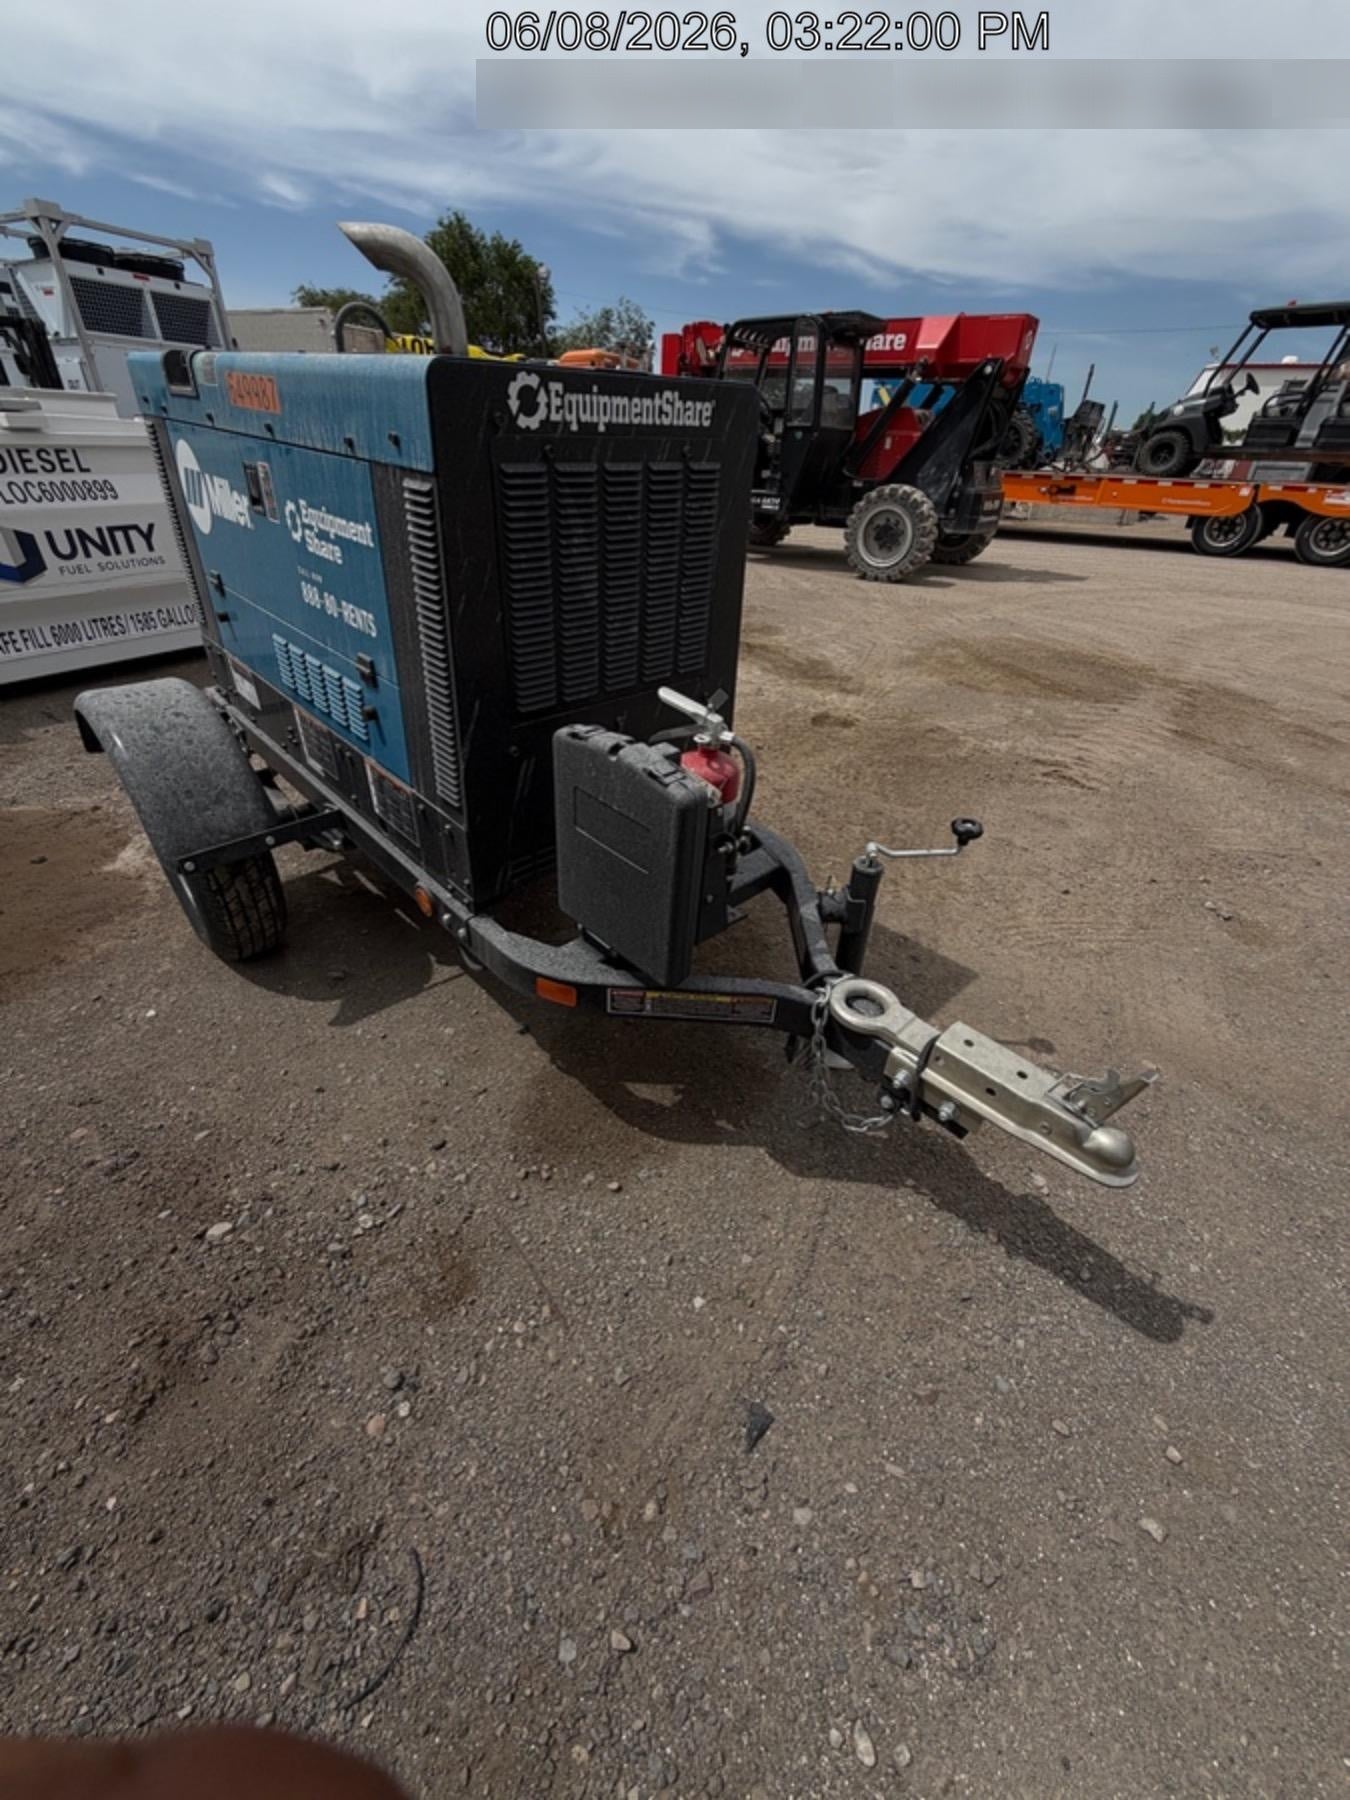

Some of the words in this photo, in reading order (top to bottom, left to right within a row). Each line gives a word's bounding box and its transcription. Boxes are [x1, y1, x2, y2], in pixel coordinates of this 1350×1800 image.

[548, 381, 712, 432] EquipmentShare
[204, 471, 253, 529] Miller
[299, 498, 374, 548] Equipment
[44, 522, 155, 561] UNITY
[304, 529, 343, 564] Share
[58, 563, 92, 577] FUEL
[97, 555, 166, 573] SOLUTIONS
[19, 625, 53, 651] FILL
[50, 621, 84, 647] 6000
[157, 603, 199, 629] GALLO
